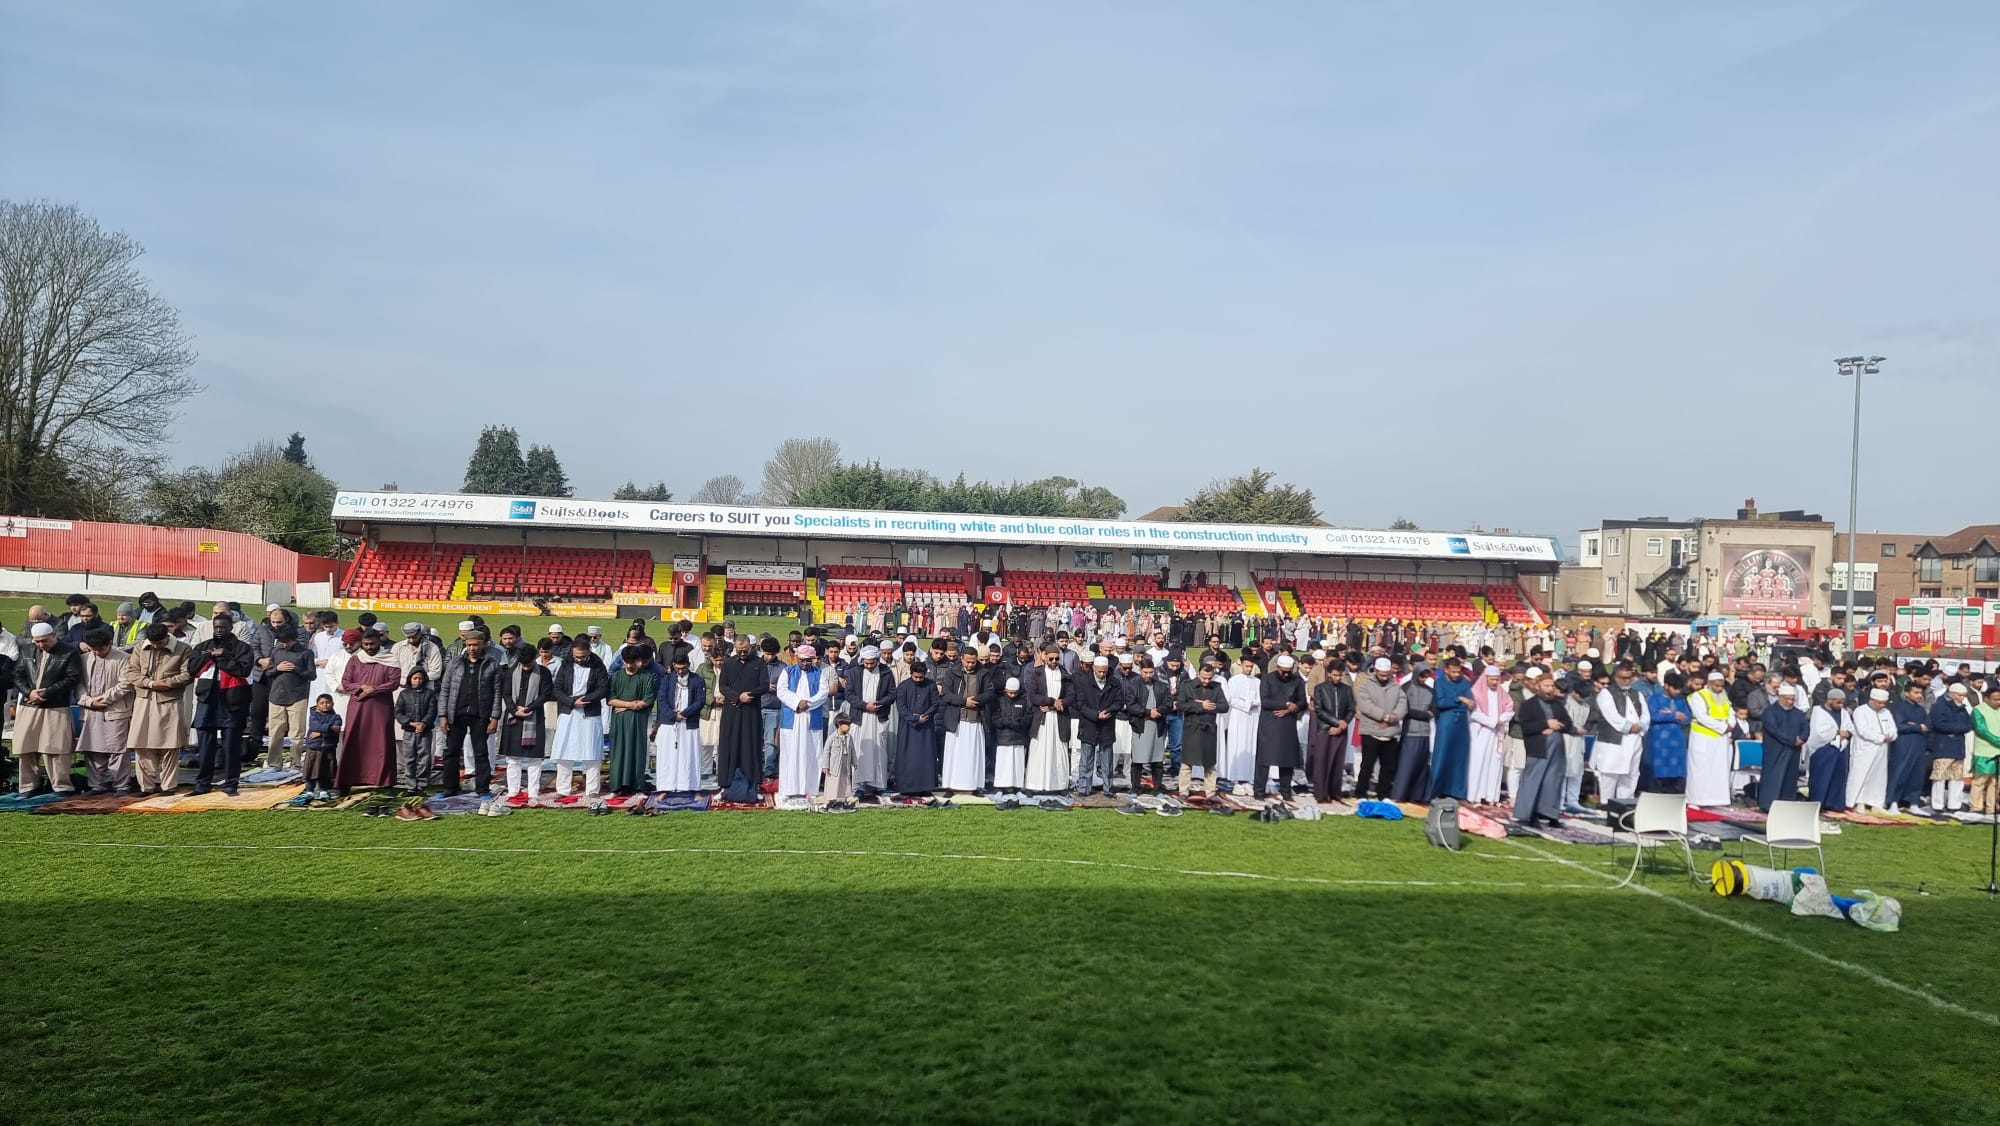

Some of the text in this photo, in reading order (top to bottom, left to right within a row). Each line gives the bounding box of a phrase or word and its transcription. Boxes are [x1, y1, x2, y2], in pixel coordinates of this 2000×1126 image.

[338, 496, 474, 510] Call 01322 474976
[540, 505, 630, 519] Suits&Boots
[650, 508, 1309, 546] Careers to SUIT you Specialists in recruiting white and blue collar roles in the construction industry
[1326, 533, 1431, 546] Call 01322 474976
[1473, 541, 1544, 554] Suits&Boots
[1731, 554, 1765, 582] WELLIN
[347, 598, 378, 611] csr
[670, 610, 698, 621] csr
